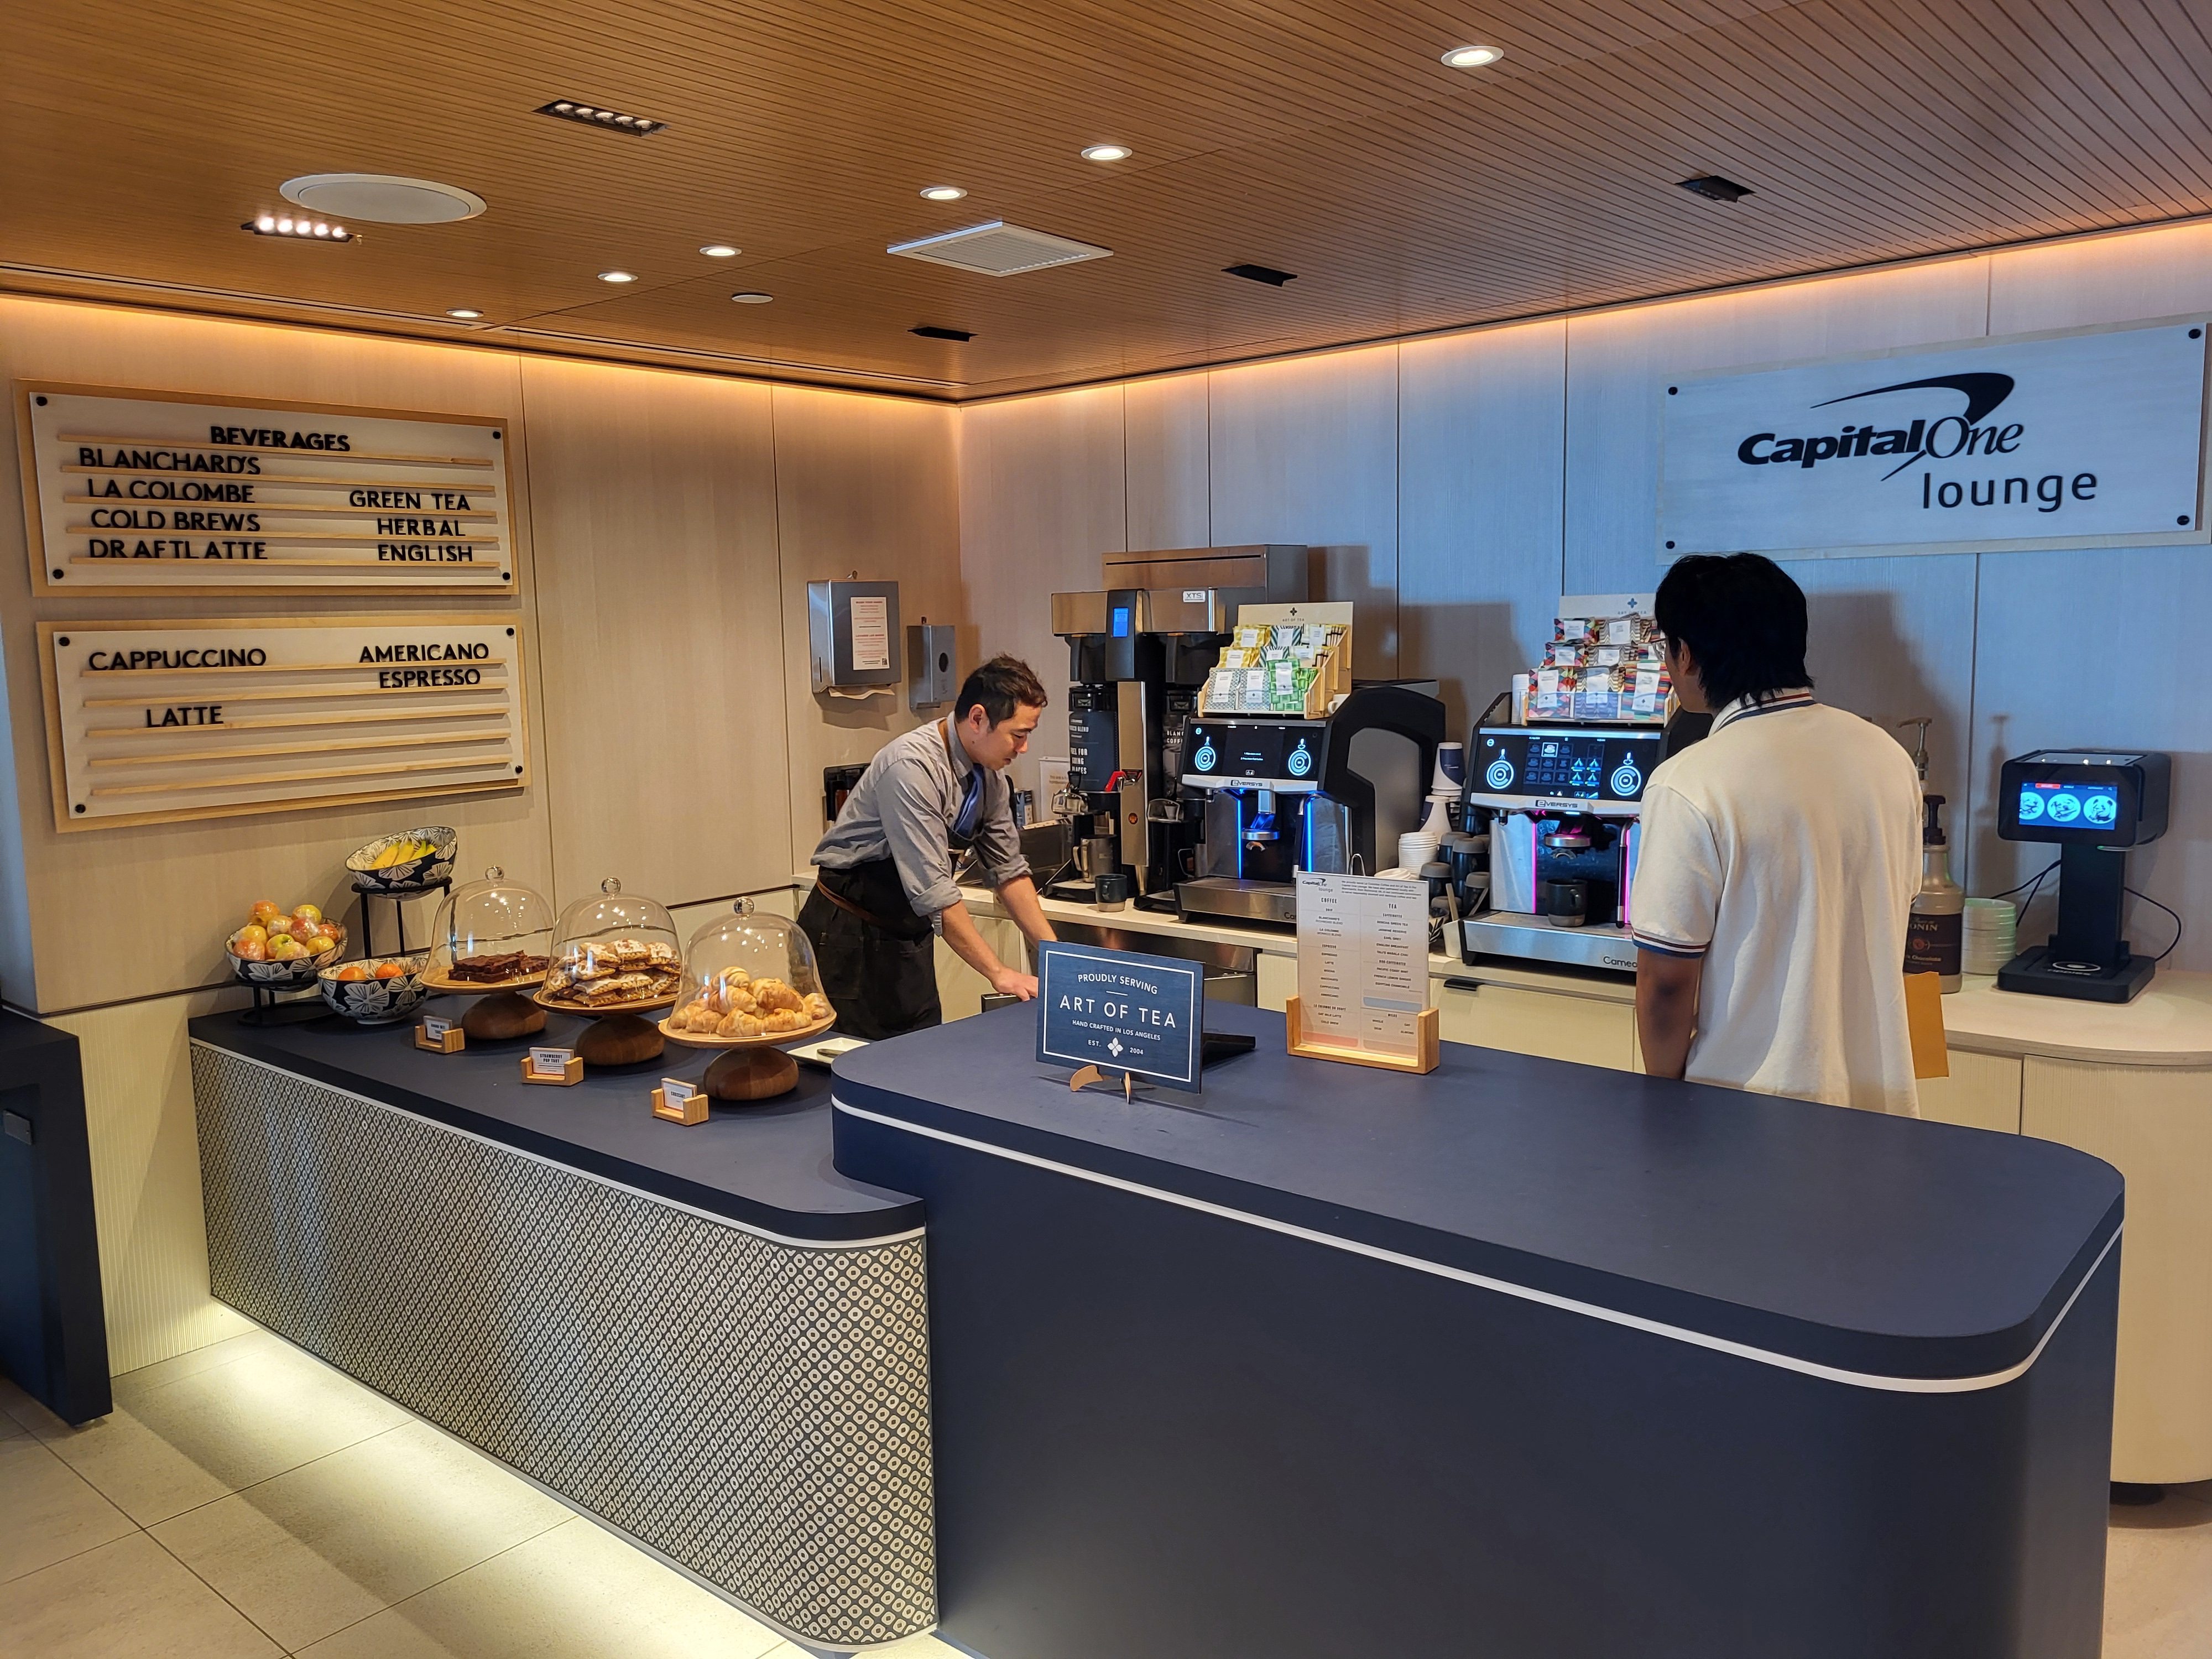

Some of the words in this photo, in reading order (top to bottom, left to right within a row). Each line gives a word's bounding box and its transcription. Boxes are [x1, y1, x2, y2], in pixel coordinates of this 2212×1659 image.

[210, 425, 350, 452] BEVERAGES
[80, 447, 261, 474] BLANCHARD'S
[88, 478, 123, 499] LA
[129, 480, 254, 504] COLOMBE
[348, 490, 421, 509] GREEN
[431, 493, 471, 511] TEA
[1923, 471, 2098, 514] lounge
[91, 509, 165, 530] COLD
[174, 512, 261, 533] BREWS
[377, 518, 466, 538] HERBAL
[377, 544, 473, 562] ENGLISH
[88, 648, 267, 671] CAPPUCCINO
[359, 643, 489, 664] AMERICANO
[378, 668, 481, 688] ESPRESSO
[145, 706, 224, 728] LATTE
[1078, 973, 1117, 983] PROUDLY
[1119, 976, 1158, 995] SERVING
[1060, 995, 1095, 1014] ART
[1104, 1002, 1129, 1019] OF
[1138, 1008, 1176, 1028] TEA
[1072, 1019, 1088, 1027] HAND
[1089, 1022, 1114, 1032] CRAFTED
[1135, 1031, 1161, 1041] ANGELES
[1129, 1047, 1144, 1055] 2004
